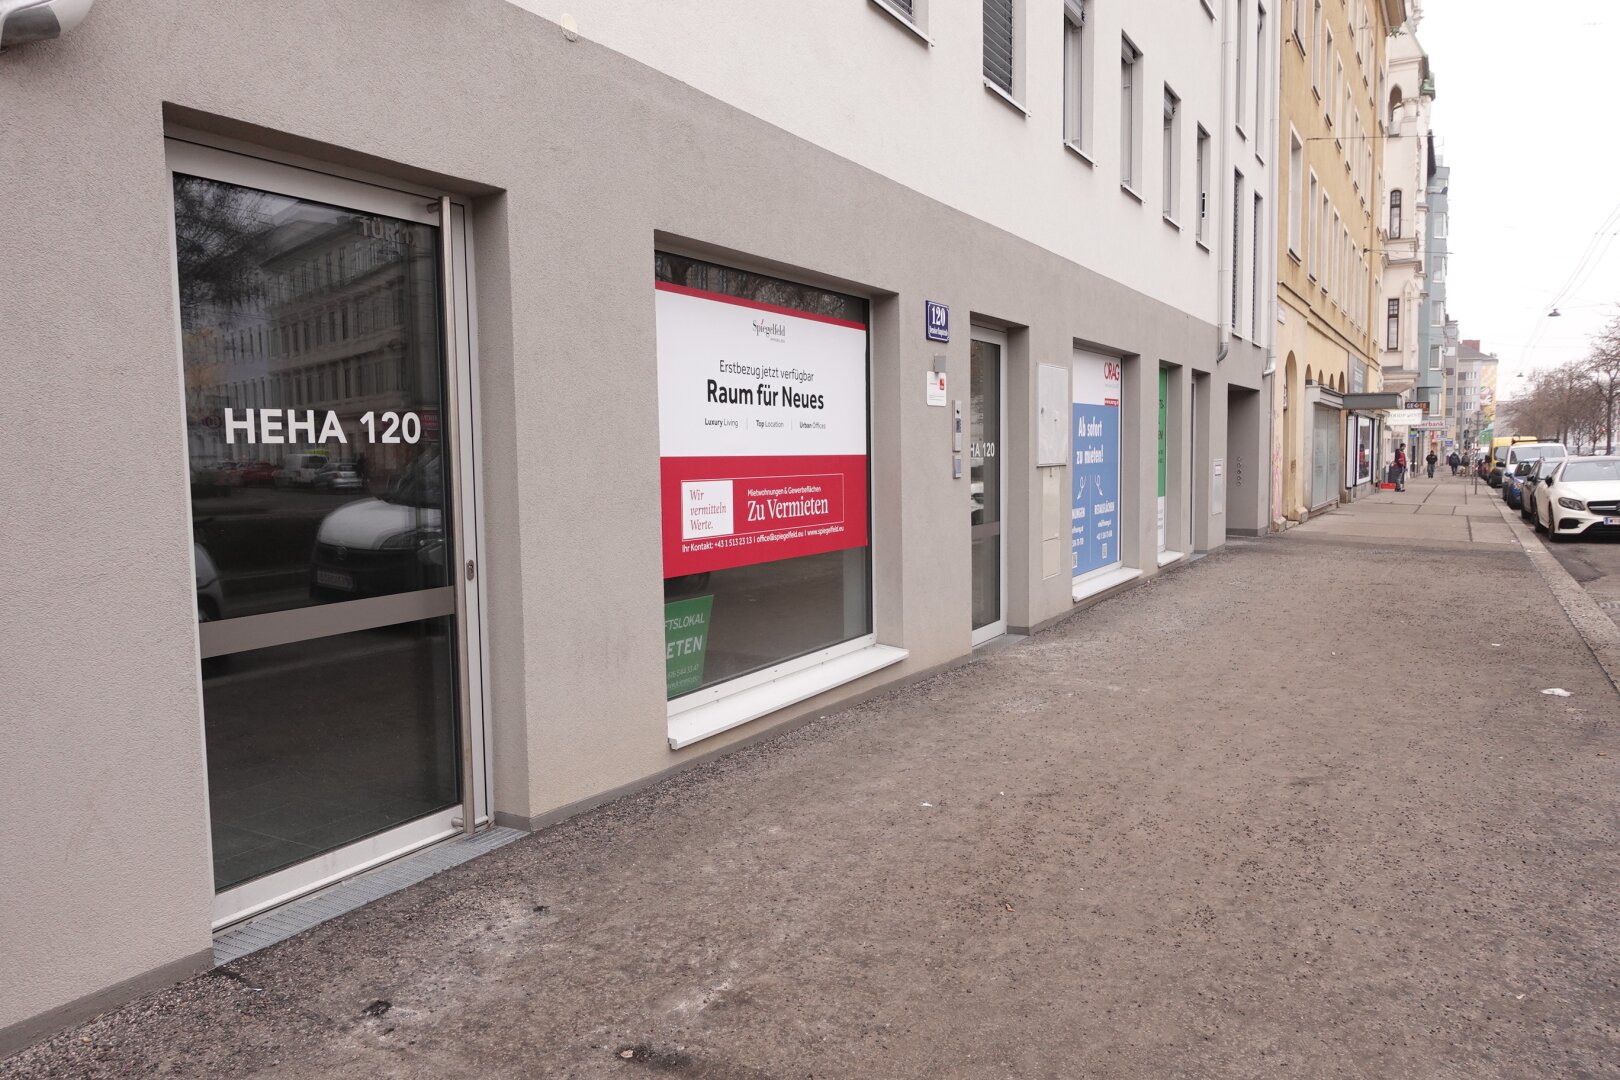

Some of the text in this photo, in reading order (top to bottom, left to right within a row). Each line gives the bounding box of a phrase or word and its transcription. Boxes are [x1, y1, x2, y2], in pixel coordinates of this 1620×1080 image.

[932, 305, 946, 327] 120
[752, 319, 786, 337] Spiegelfeld
[719, 359, 815, 384] Erstbezug jetzt verfügbar
[707, 378, 825, 410] Raum für Neues
[224, 407, 422, 444] HEHA 120
[704, 418, 739, 429] Luxury Living
[756, 420, 785, 429] Top Location
[1078, 416, 1103, 438] Ab sofort
[983, 442, 995, 457] 120
[1076, 444, 1104, 465] zu mieten!
[690, 489, 705, 501] Wir
[690, 502, 727, 516] vermitteln
[747, 495, 829, 522] Zu Vermieten
[690, 519, 714, 531] Werte.
[682, 544, 690, 553] Ihr
[690, 542, 714, 552] Kontakt:
[714, 539, 725, 548] +43
[729, 538, 739, 548] 513
[739, 537, 746, 547] 23
[746, 536, 753, 545] 13
